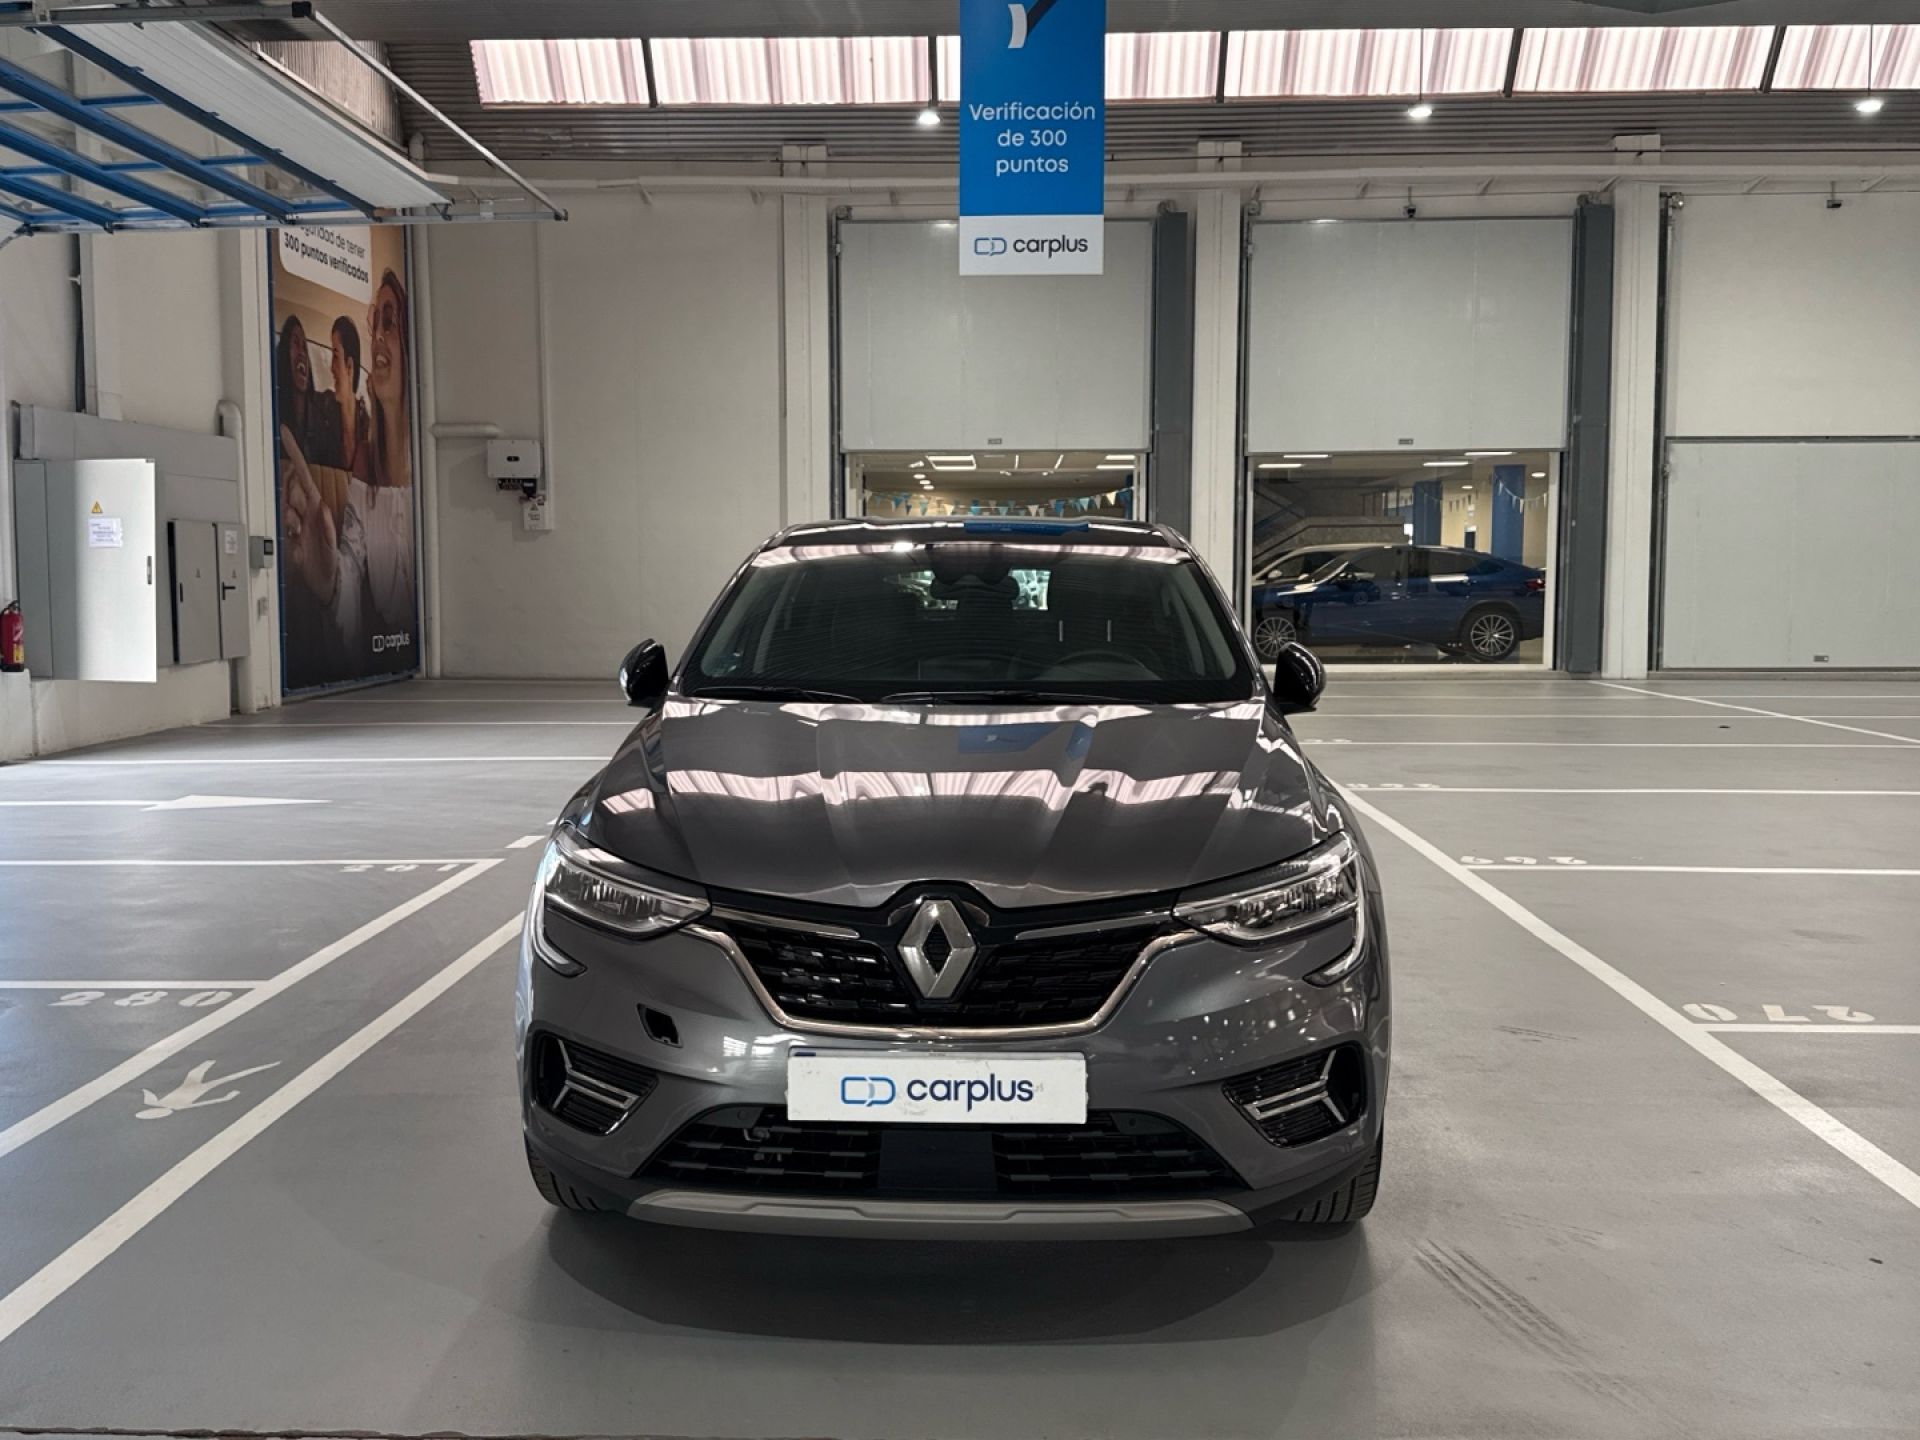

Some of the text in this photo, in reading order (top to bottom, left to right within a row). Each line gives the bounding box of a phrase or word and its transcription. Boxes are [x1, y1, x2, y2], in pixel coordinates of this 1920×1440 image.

[968, 102, 1096, 121] Verificación
[997, 129, 1068, 147] de 300
[995, 158, 1069, 177] puntos
[1012, 234, 1089, 259] carplus
[284, 231, 369, 284] 300 puntos verificados
[47, 990, 233, 1007] 280
[1681, 1002, 1876, 1023] 270
[906, 1072, 1034, 1112] carplus
